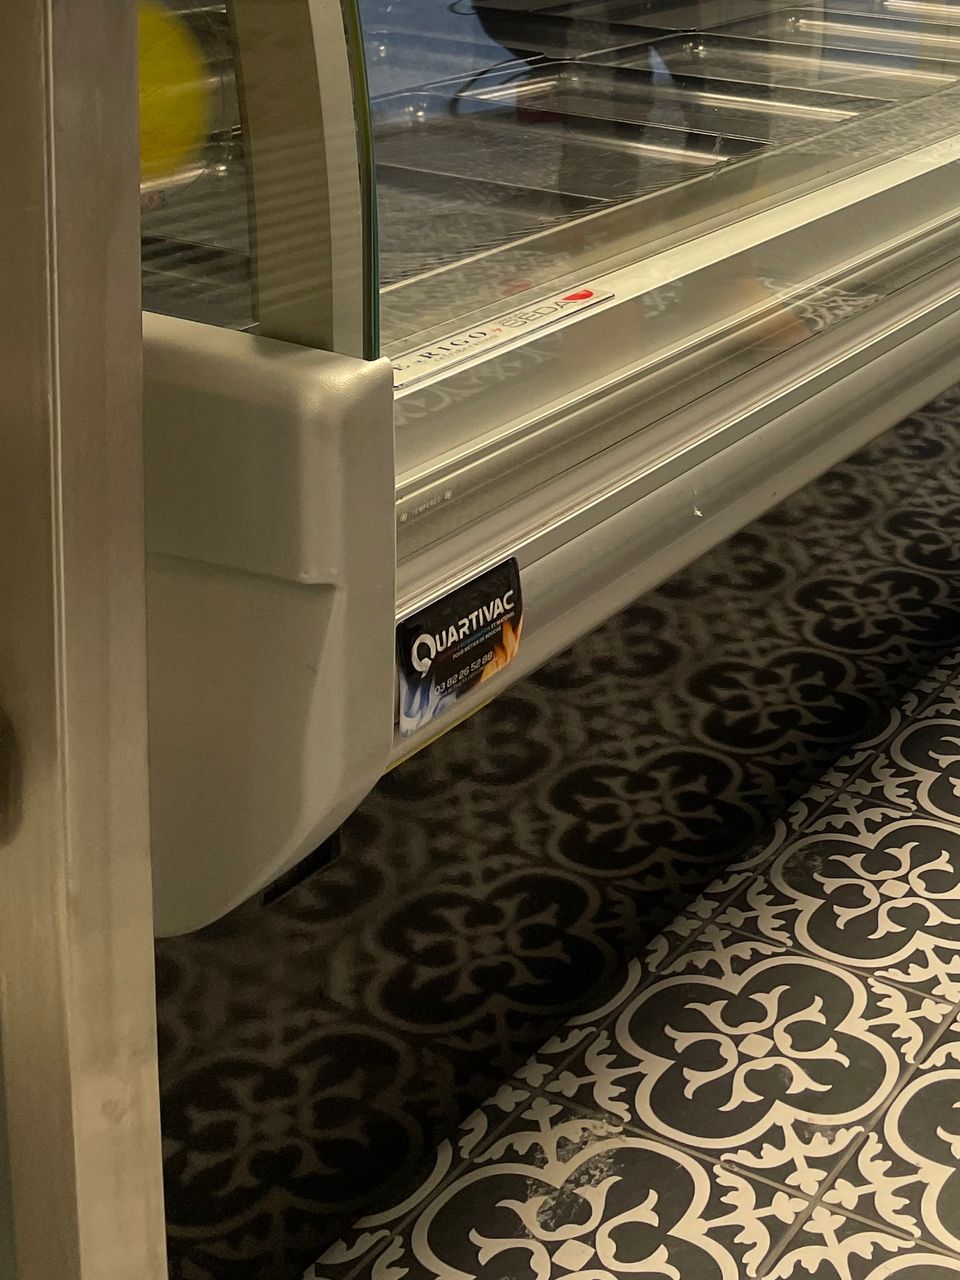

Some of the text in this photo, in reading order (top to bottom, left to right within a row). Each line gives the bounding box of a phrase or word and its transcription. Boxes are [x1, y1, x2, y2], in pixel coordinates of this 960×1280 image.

[502, 301, 577, 328] SEDA
[411, 589, 515, 679] QUARTIVAC
[434, 682, 446, 696] 03
[470, 658, 481, 672] 52
